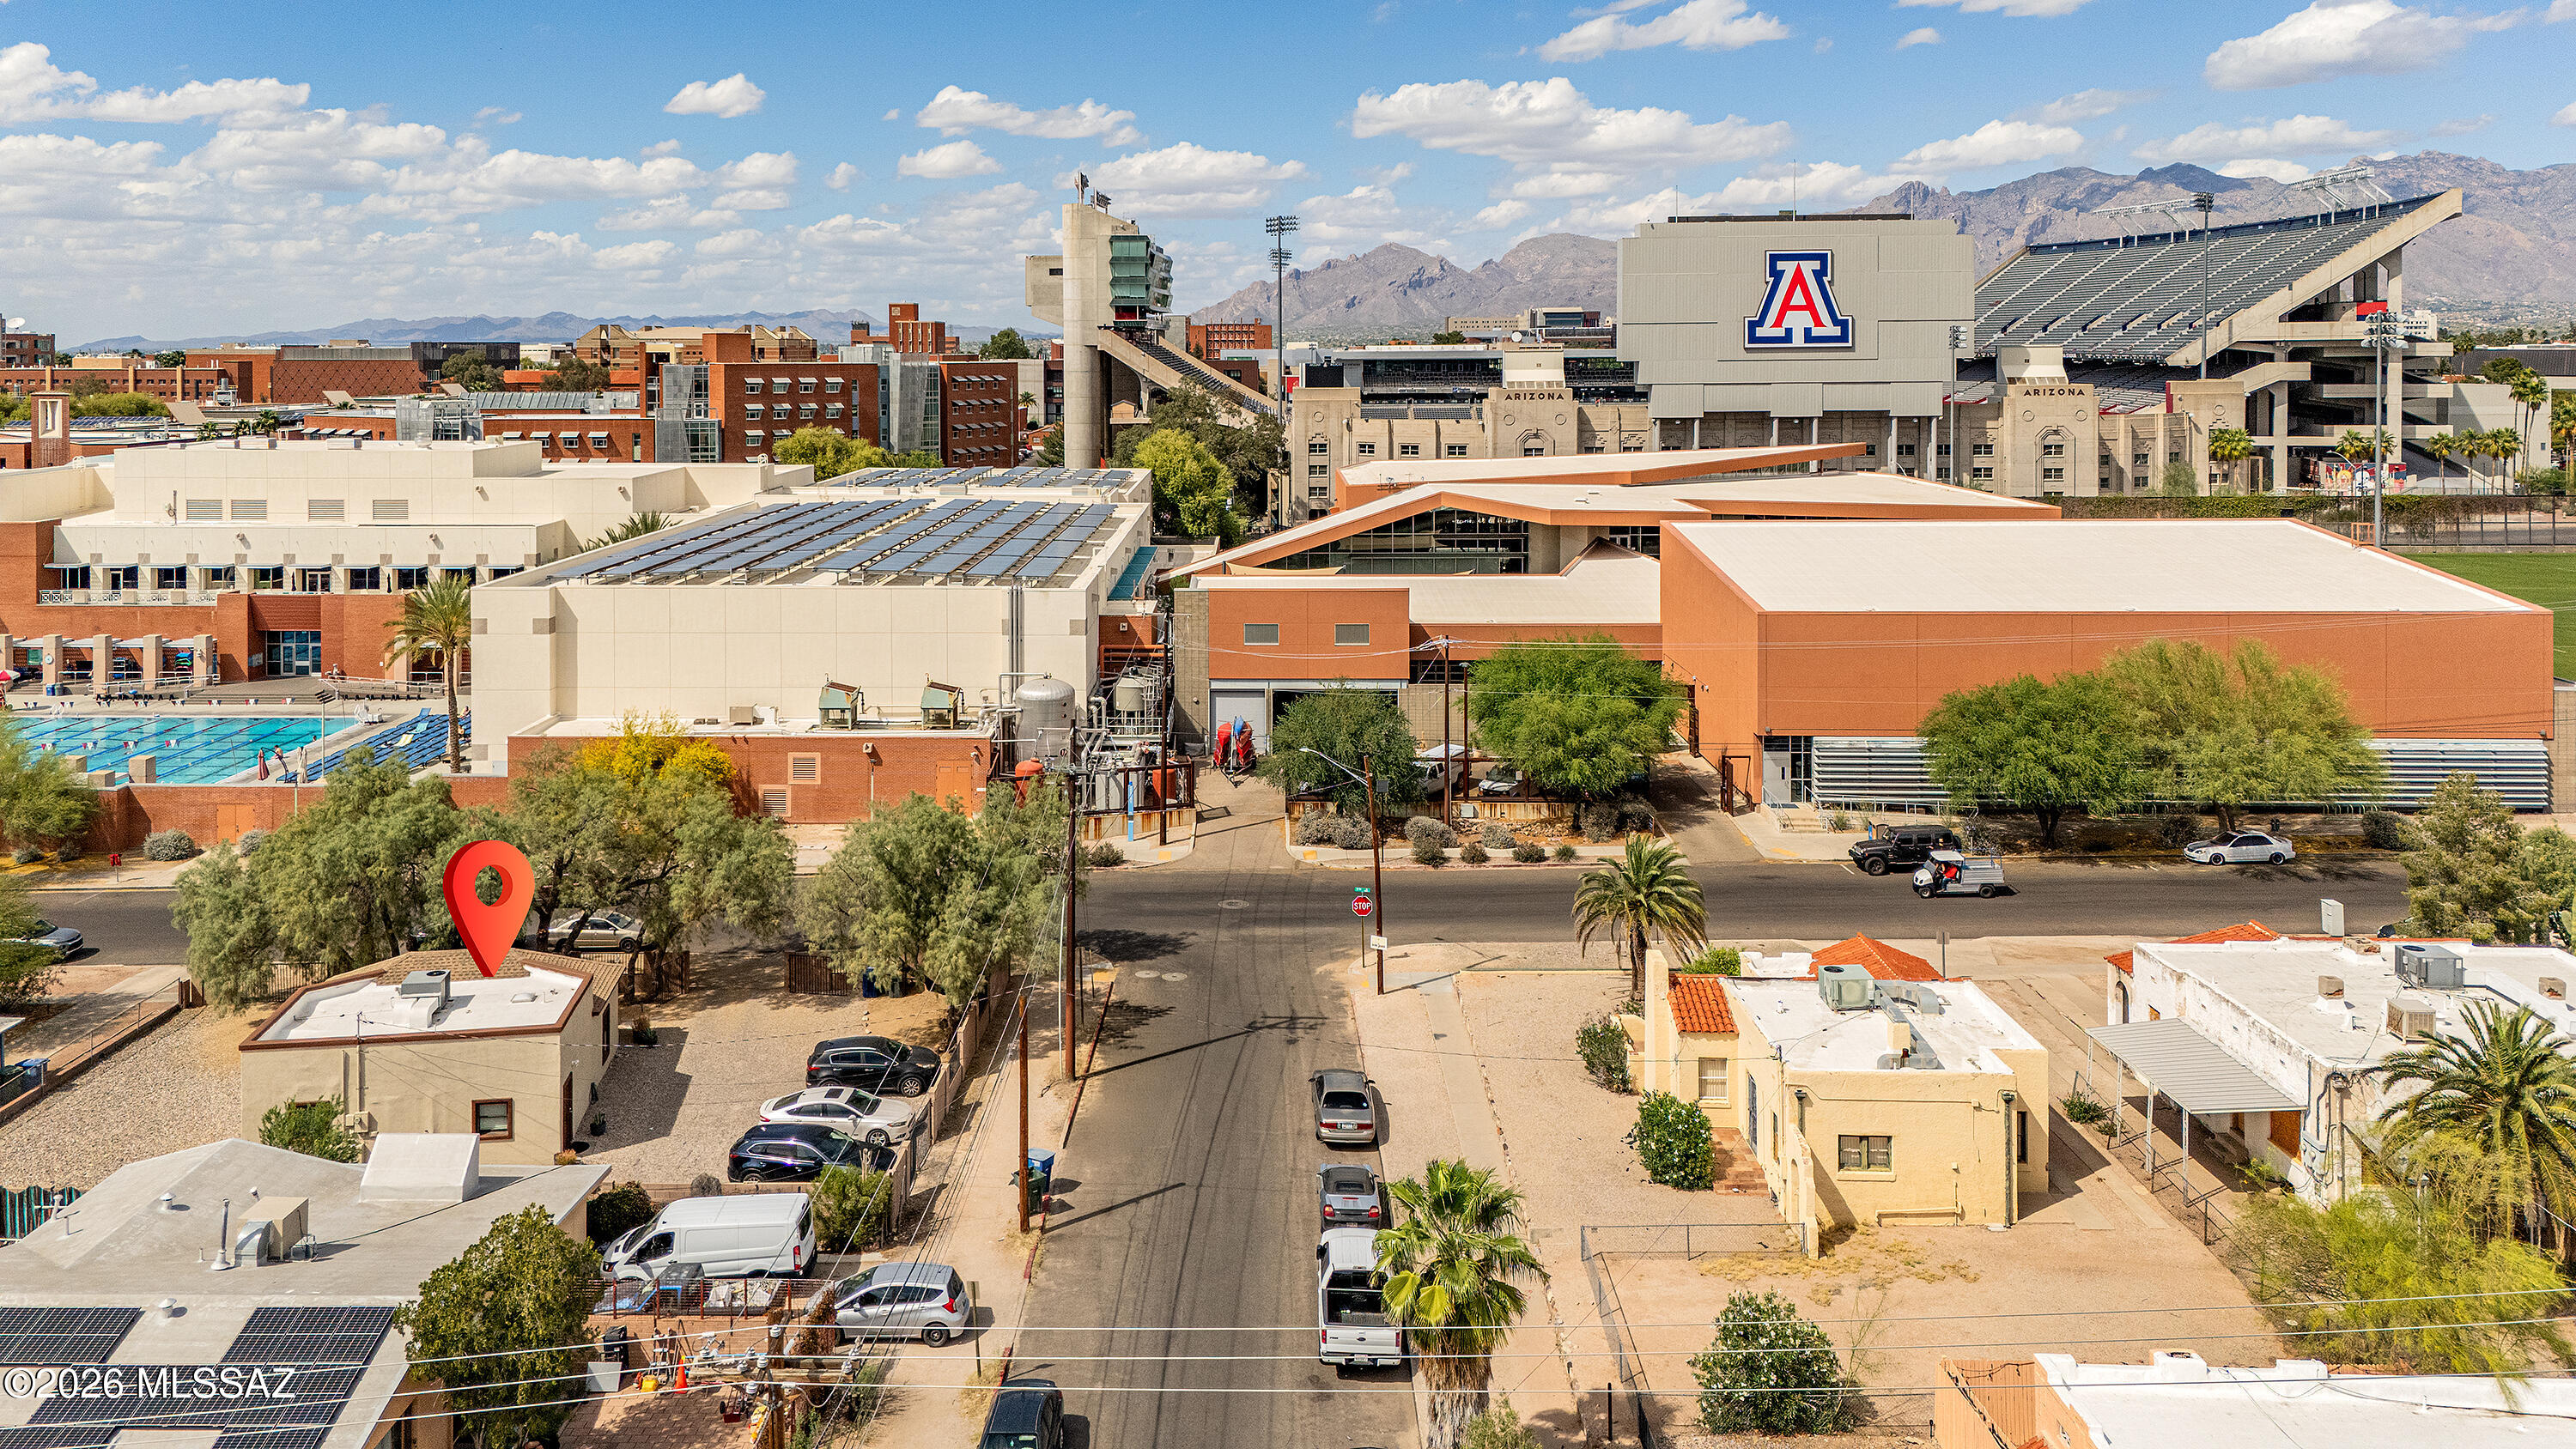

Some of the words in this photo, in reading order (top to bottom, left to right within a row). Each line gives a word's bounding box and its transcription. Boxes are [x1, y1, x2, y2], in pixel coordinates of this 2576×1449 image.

[1744, 249, 1852, 349] A
[1504, 392, 1564, 401] ARIZONA
[2023, 388, 2086, 397] ARIZONA
[1353, 901, 1371, 911] STOP
